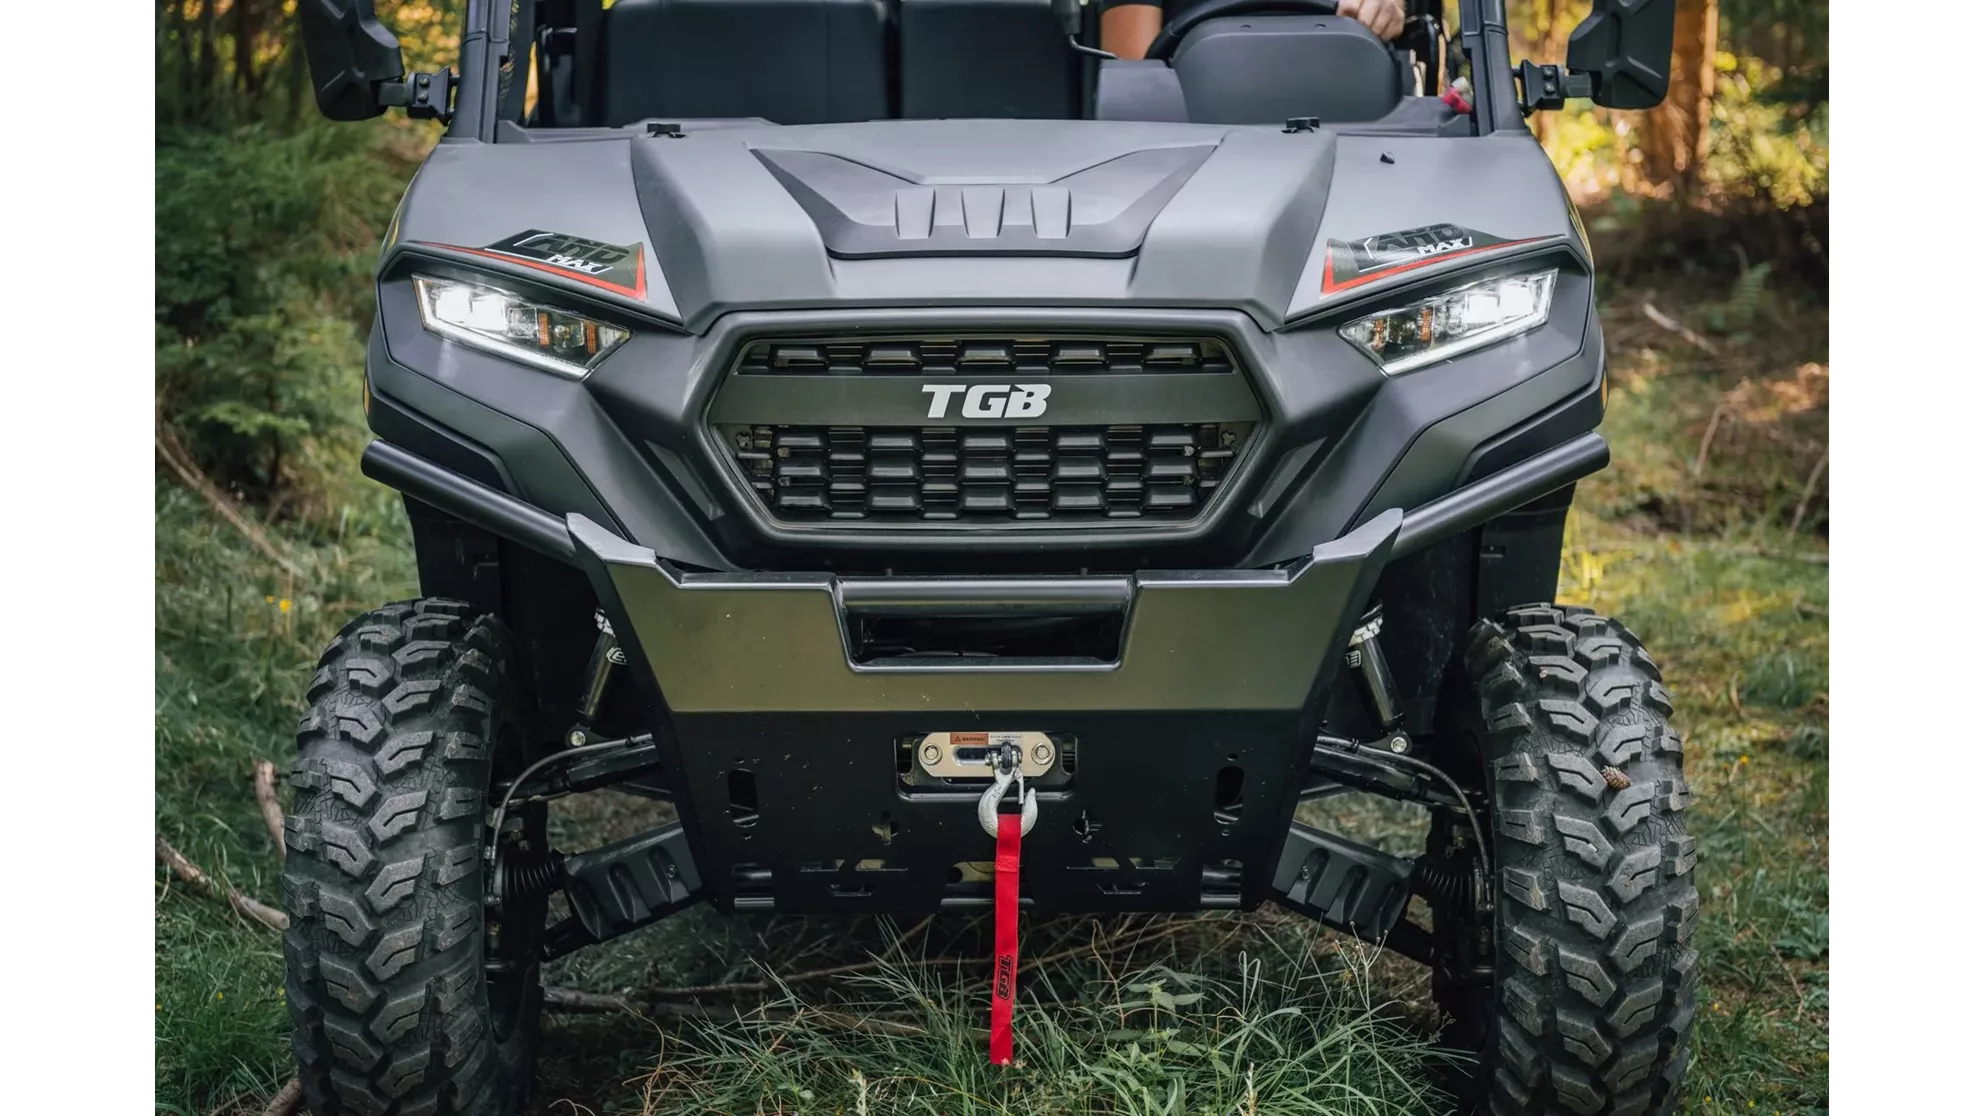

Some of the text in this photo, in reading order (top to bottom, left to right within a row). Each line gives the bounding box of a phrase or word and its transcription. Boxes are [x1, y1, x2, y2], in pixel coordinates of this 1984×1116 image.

[1417, 238, 1463, 256] MAX
[546, 254, 603, 272] MAX
[921, 383, 1052, 419] TGB
[997, 955, 1013, 999] TGB
